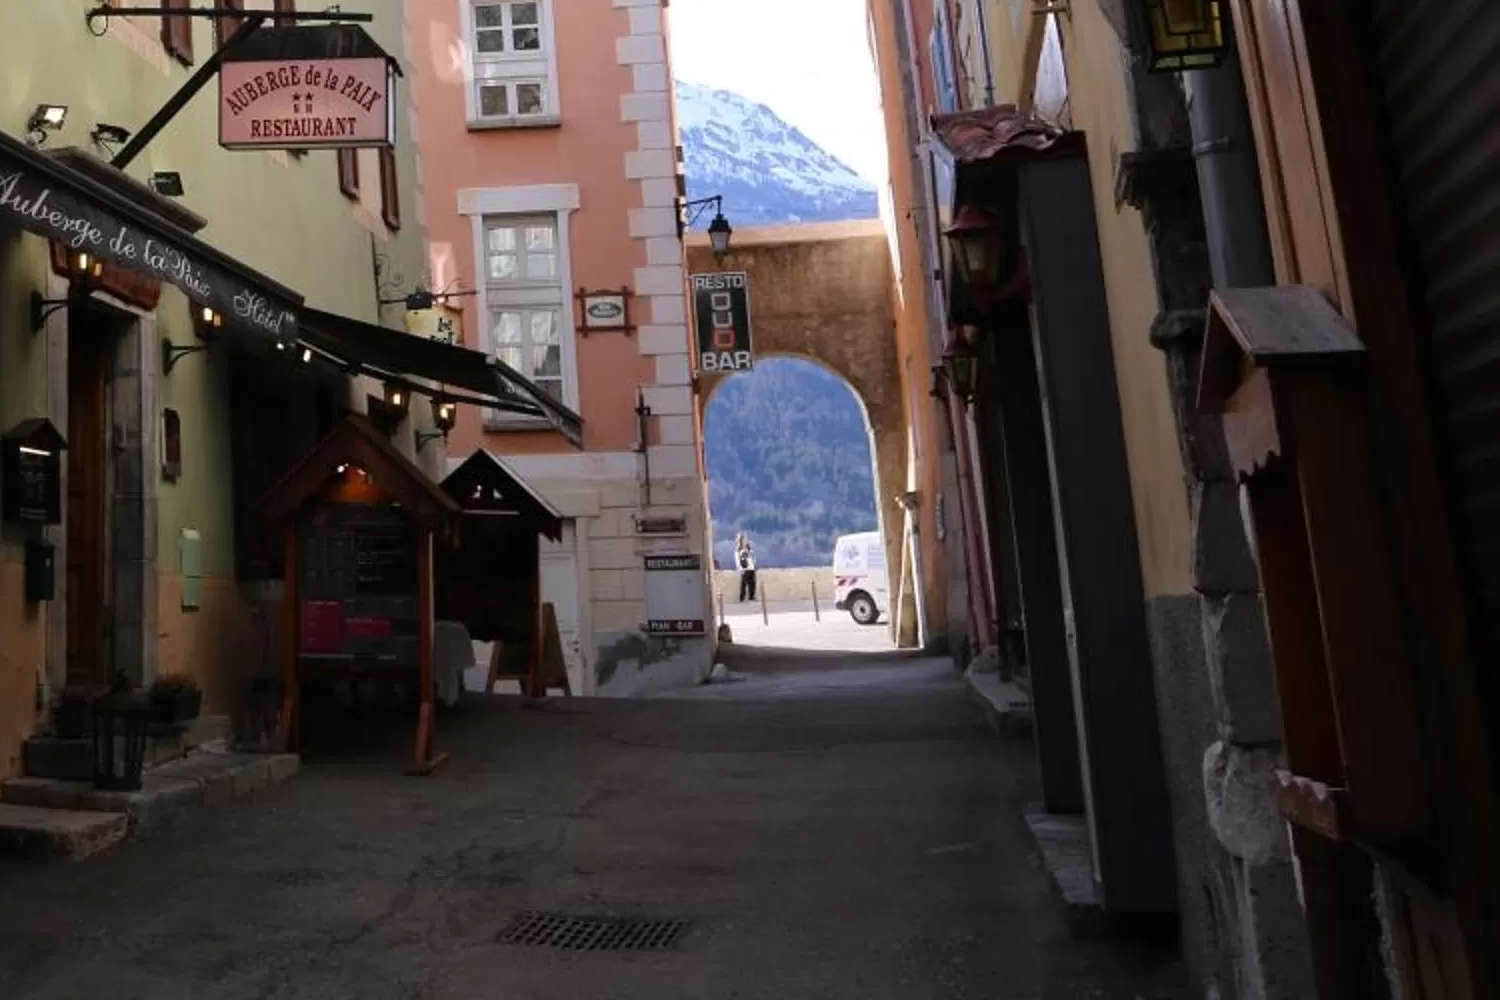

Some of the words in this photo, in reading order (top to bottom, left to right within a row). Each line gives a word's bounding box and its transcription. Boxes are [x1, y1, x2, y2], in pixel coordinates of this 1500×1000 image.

[226, 65, 300, 115] AUBERGE
[305, 64, 321, 86] de
[324, 68, 339, 91] la
[340, 75, 382, 112] PAIX
[251, 117, 356, 137] RESTAURANT
[109, 227, 136, 259] de
[143, 239, 168, 270] la
[695, 275, 743, 291] RESTO
[701, 350, 751, 370] BAR
